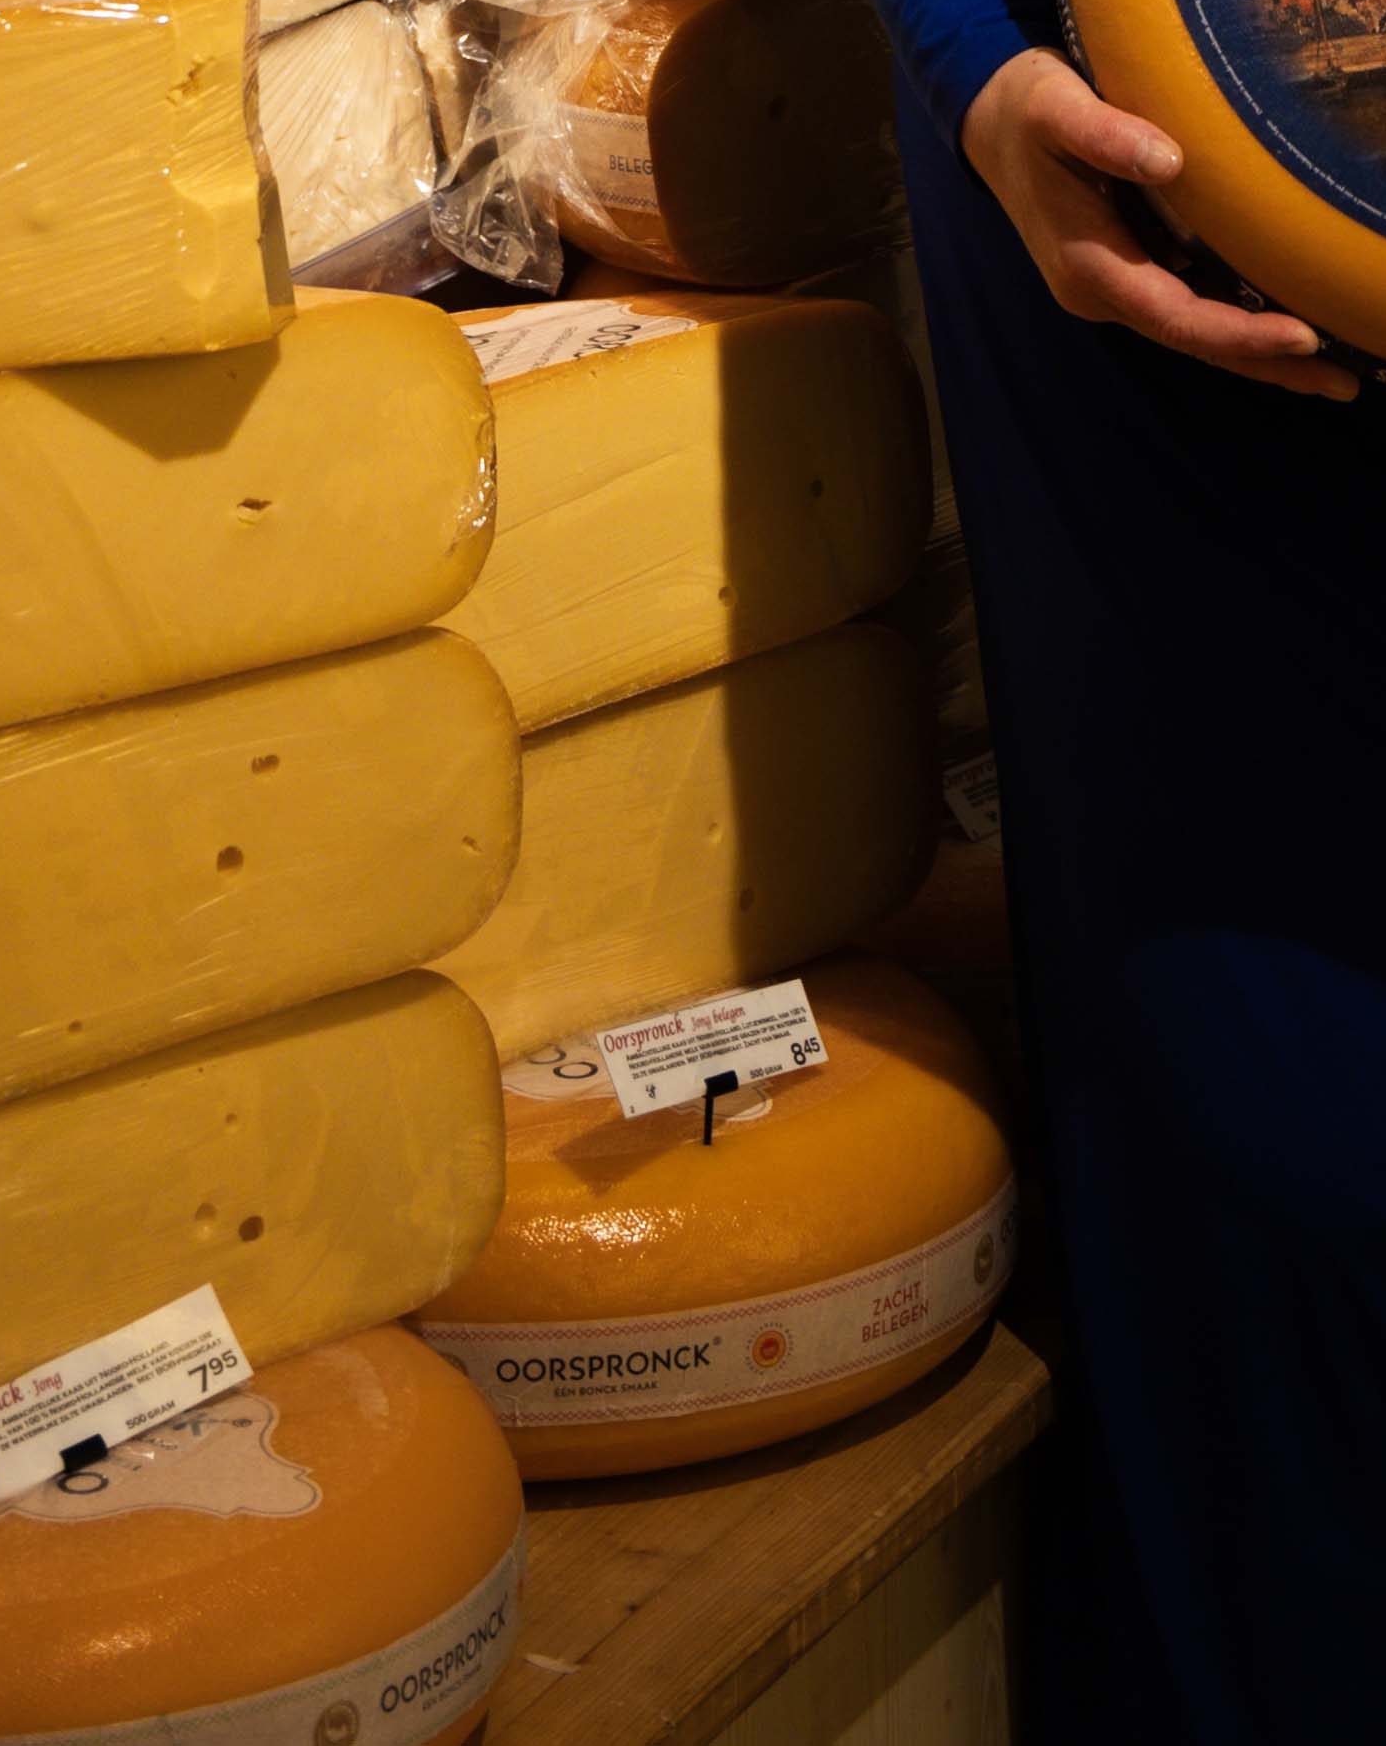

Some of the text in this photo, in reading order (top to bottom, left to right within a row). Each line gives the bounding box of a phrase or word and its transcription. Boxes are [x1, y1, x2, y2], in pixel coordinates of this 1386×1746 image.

[604, 1005, 746, 1054] Oorspronck Jong belegen
[764, 1064, 783, 1076] GRAM
[791, 1037, 821, 1066] 845
[872, 1280, 922, 1318] ZACHT
[861, 1298, 930, 1344] BELEGEN
[32, 1371, 64, 1397] Jong
[187, 1350, 238, 1394] 795
[496, 1344, 712, 1385] OORSPRONCK
[0, 1391, 62, 1427] AMBACHTELIJKE
[60, 1381, 84, 1398] KAAS
[83, 1374, 99, 1388] UIT
[5, 1422, 24, 1436] VAN
[23, 1414, 41, 1428] 100
[149, 1352, 168, 1367] VAN
[579, 1380, 659, 1396] BONCK SMAAK
[125, 1399, 177, 1430] 500 GRAM
[381, 1601, 506, 1713] OORSPRONCK
